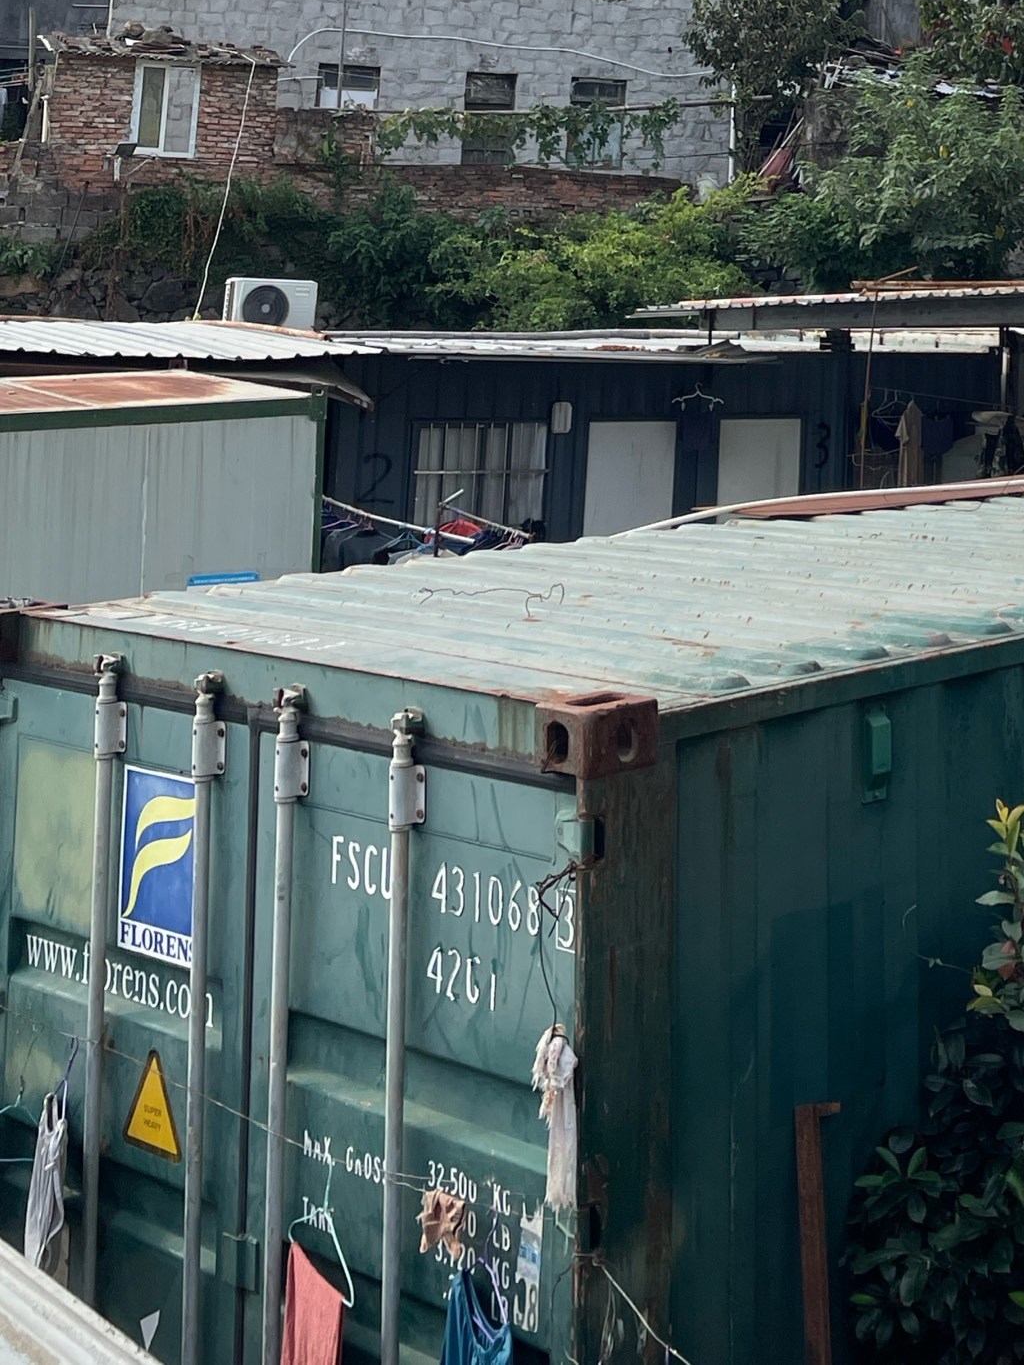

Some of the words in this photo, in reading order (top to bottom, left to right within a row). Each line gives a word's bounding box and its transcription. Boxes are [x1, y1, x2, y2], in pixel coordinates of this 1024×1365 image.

[815, 422, 831, 469] 3
[358, 453, 395, 504] 2
[331, 835, 392, 900] FSCU
[431, 861, 541, 936] 431068
[558, 895, 574, 948] 3
